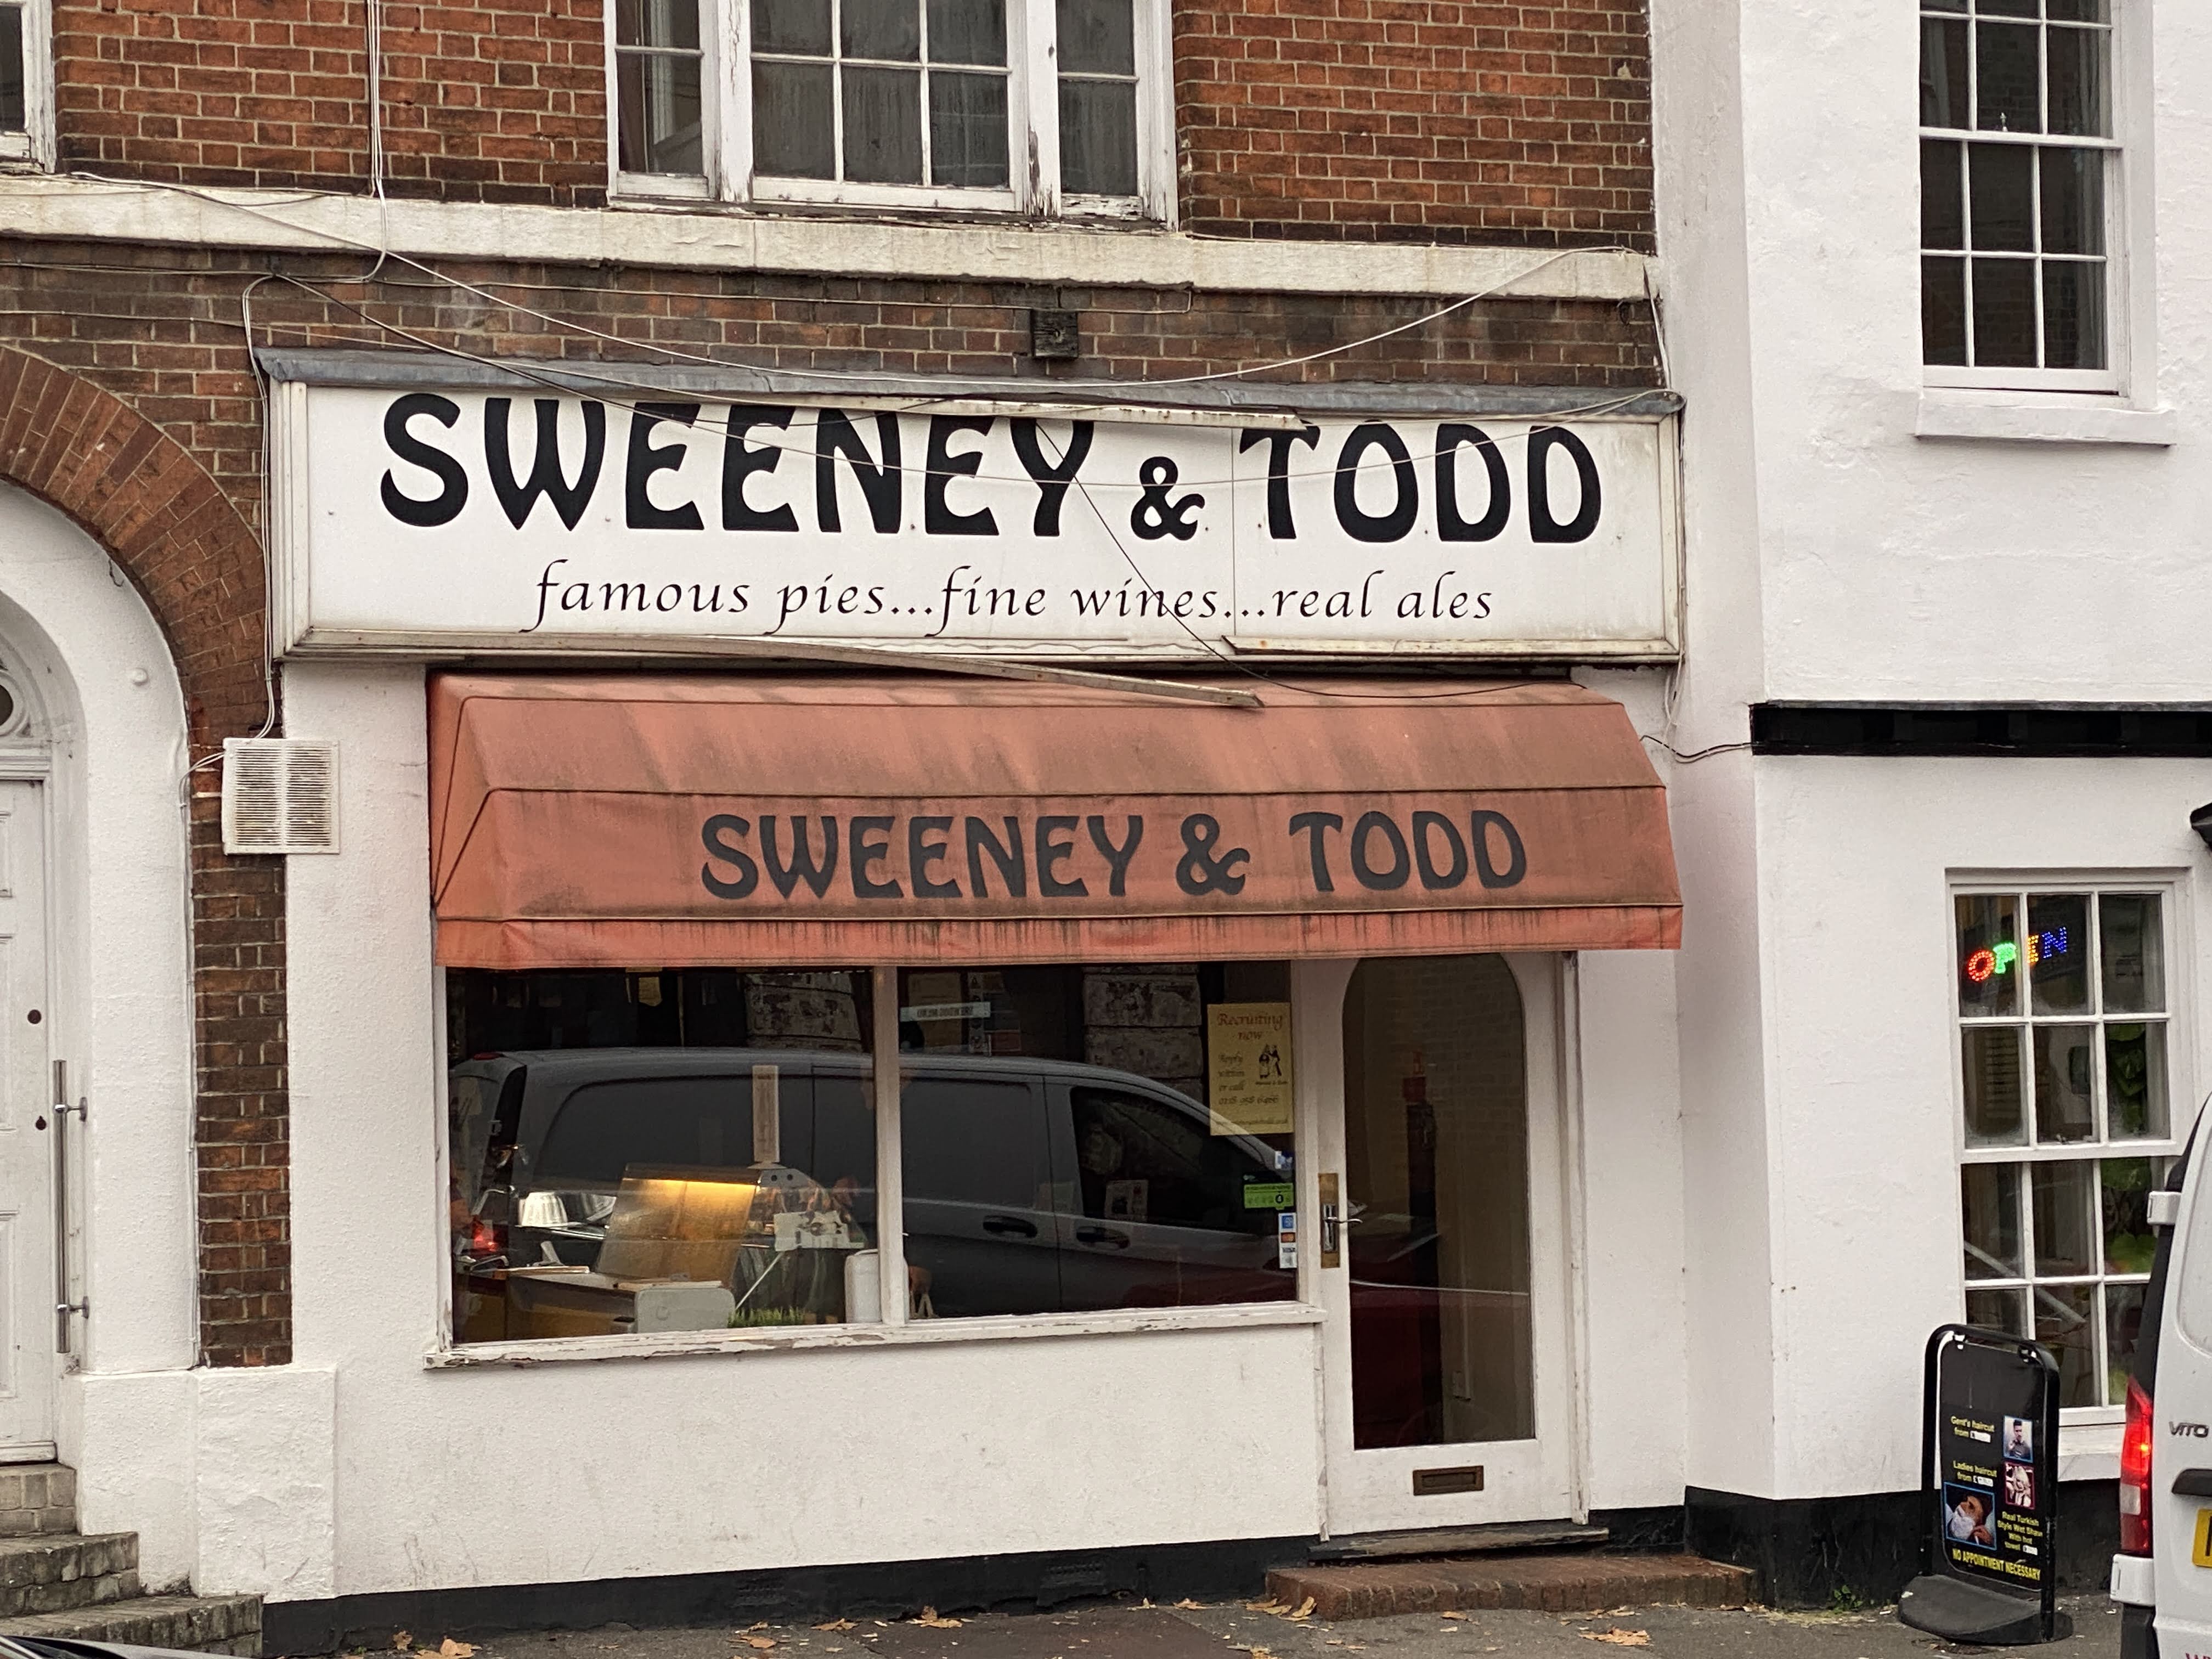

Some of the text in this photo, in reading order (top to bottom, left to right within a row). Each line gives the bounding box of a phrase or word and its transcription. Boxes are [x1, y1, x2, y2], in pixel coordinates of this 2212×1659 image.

[380, 393, 1601, 543] SWEENEY & TODD
[518, 559, 750, 633] famous
[1397, 571, 1493, 619] ales
[701, 810, 1526, 899] SWEENEY & TODD
[1967, 926, 2068, 982] OPEN
[1217, 1013, 1283, 1031] Recruiting
[1238, 1031, 1264, 1040] now
[1951, 1415, 1995, 1432] Gent's haircut
[1954, 1426, 1970, 1438] from
[2169, 1421, 2209, 1438] VITO
[1953, 1460, 1997, 1477] Ladies haircut
[1957, 1471, 1972, 1482] from
[2002, 1511, 2039, 1527] Real Turkish
[1951, 1548, 1962, 1561] NO
[1962, 1550, 2005, 1572] APPOINTMENT
[2005, 1561, 2041, 1581] NECESSARY
